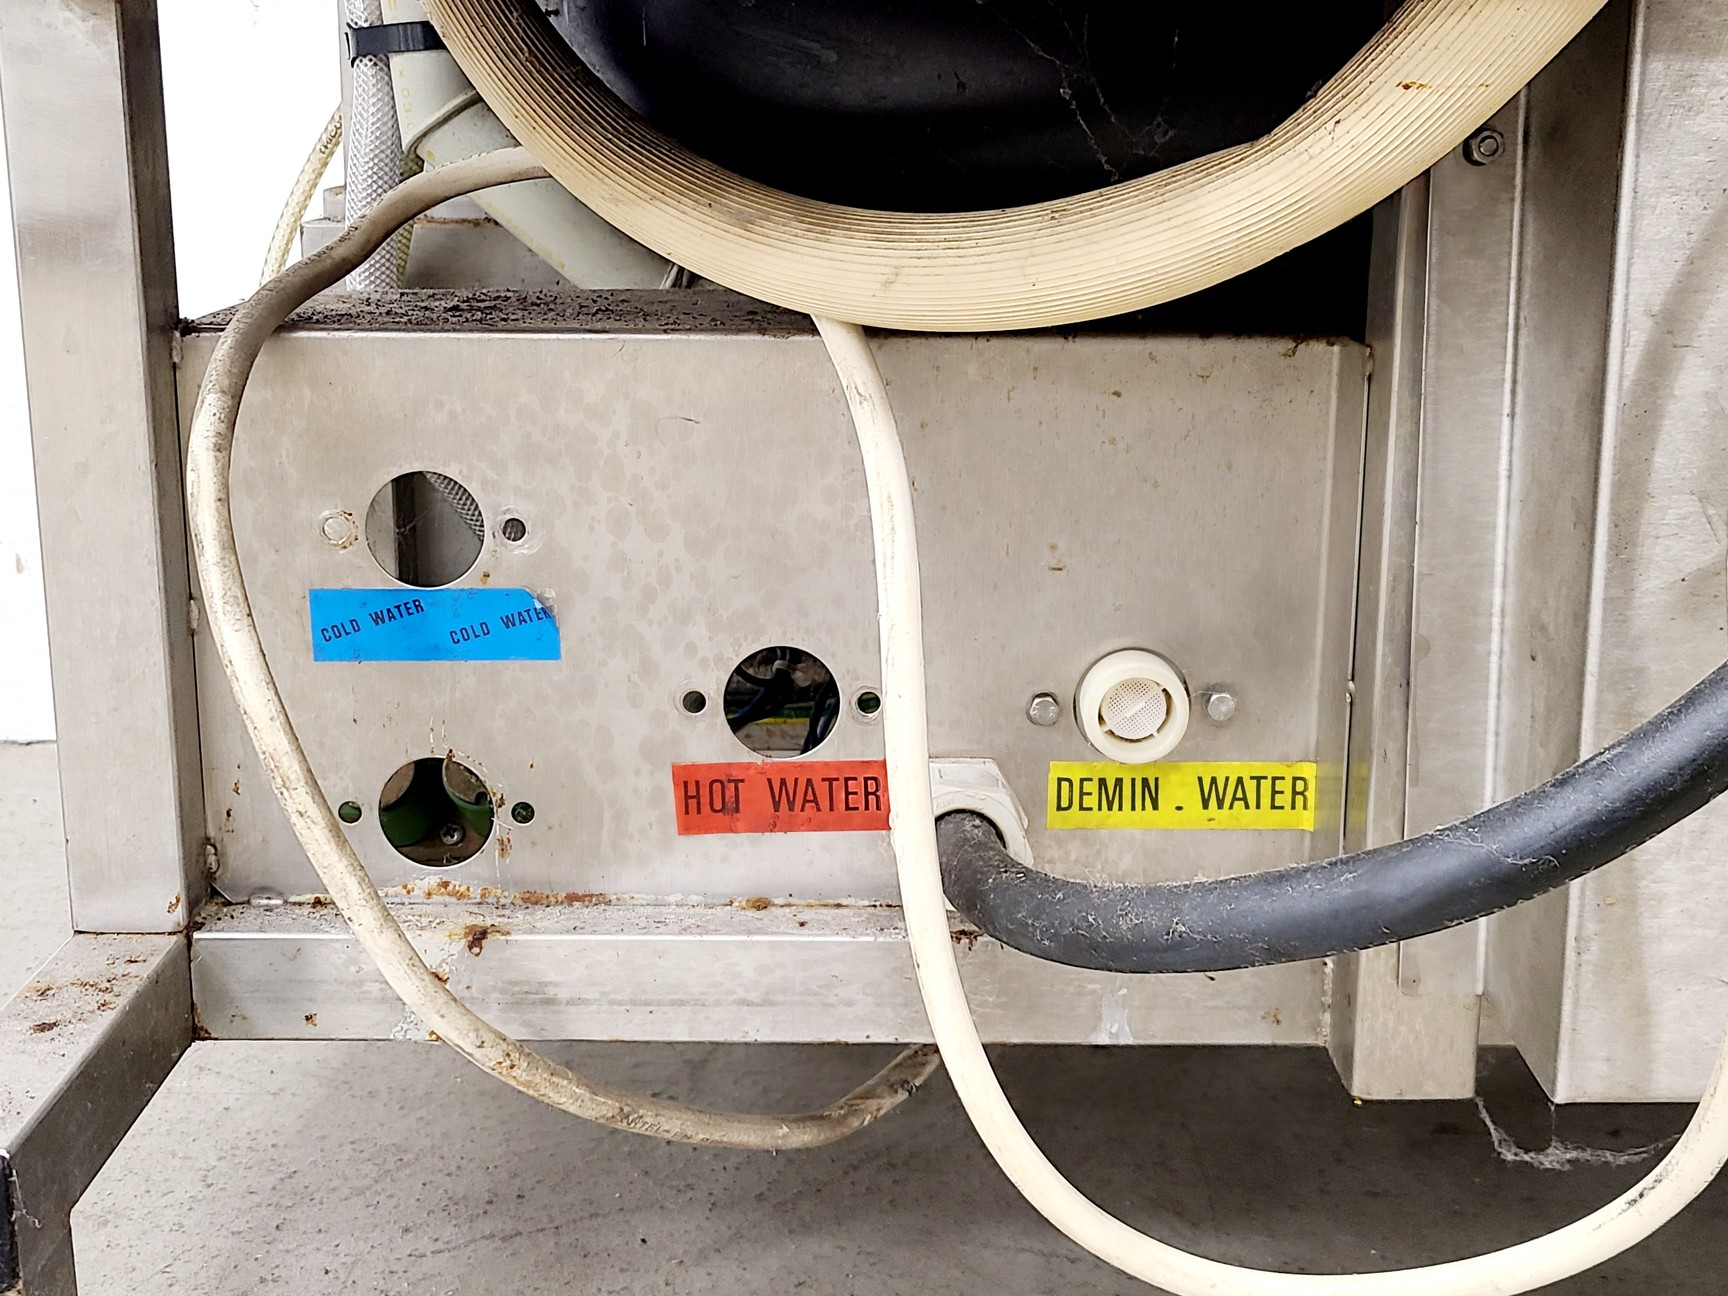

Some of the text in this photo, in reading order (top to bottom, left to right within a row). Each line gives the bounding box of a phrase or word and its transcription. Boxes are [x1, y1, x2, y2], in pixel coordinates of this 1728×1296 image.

[320, 598, 425, 643] COLD WATER
[449, 621, 491, 645] COLD
[683, 776, 882, 816] HOT WATER
[1055, 776, 1160, 812] DEMIN
[1197, 775, 1309, 811] WATER
